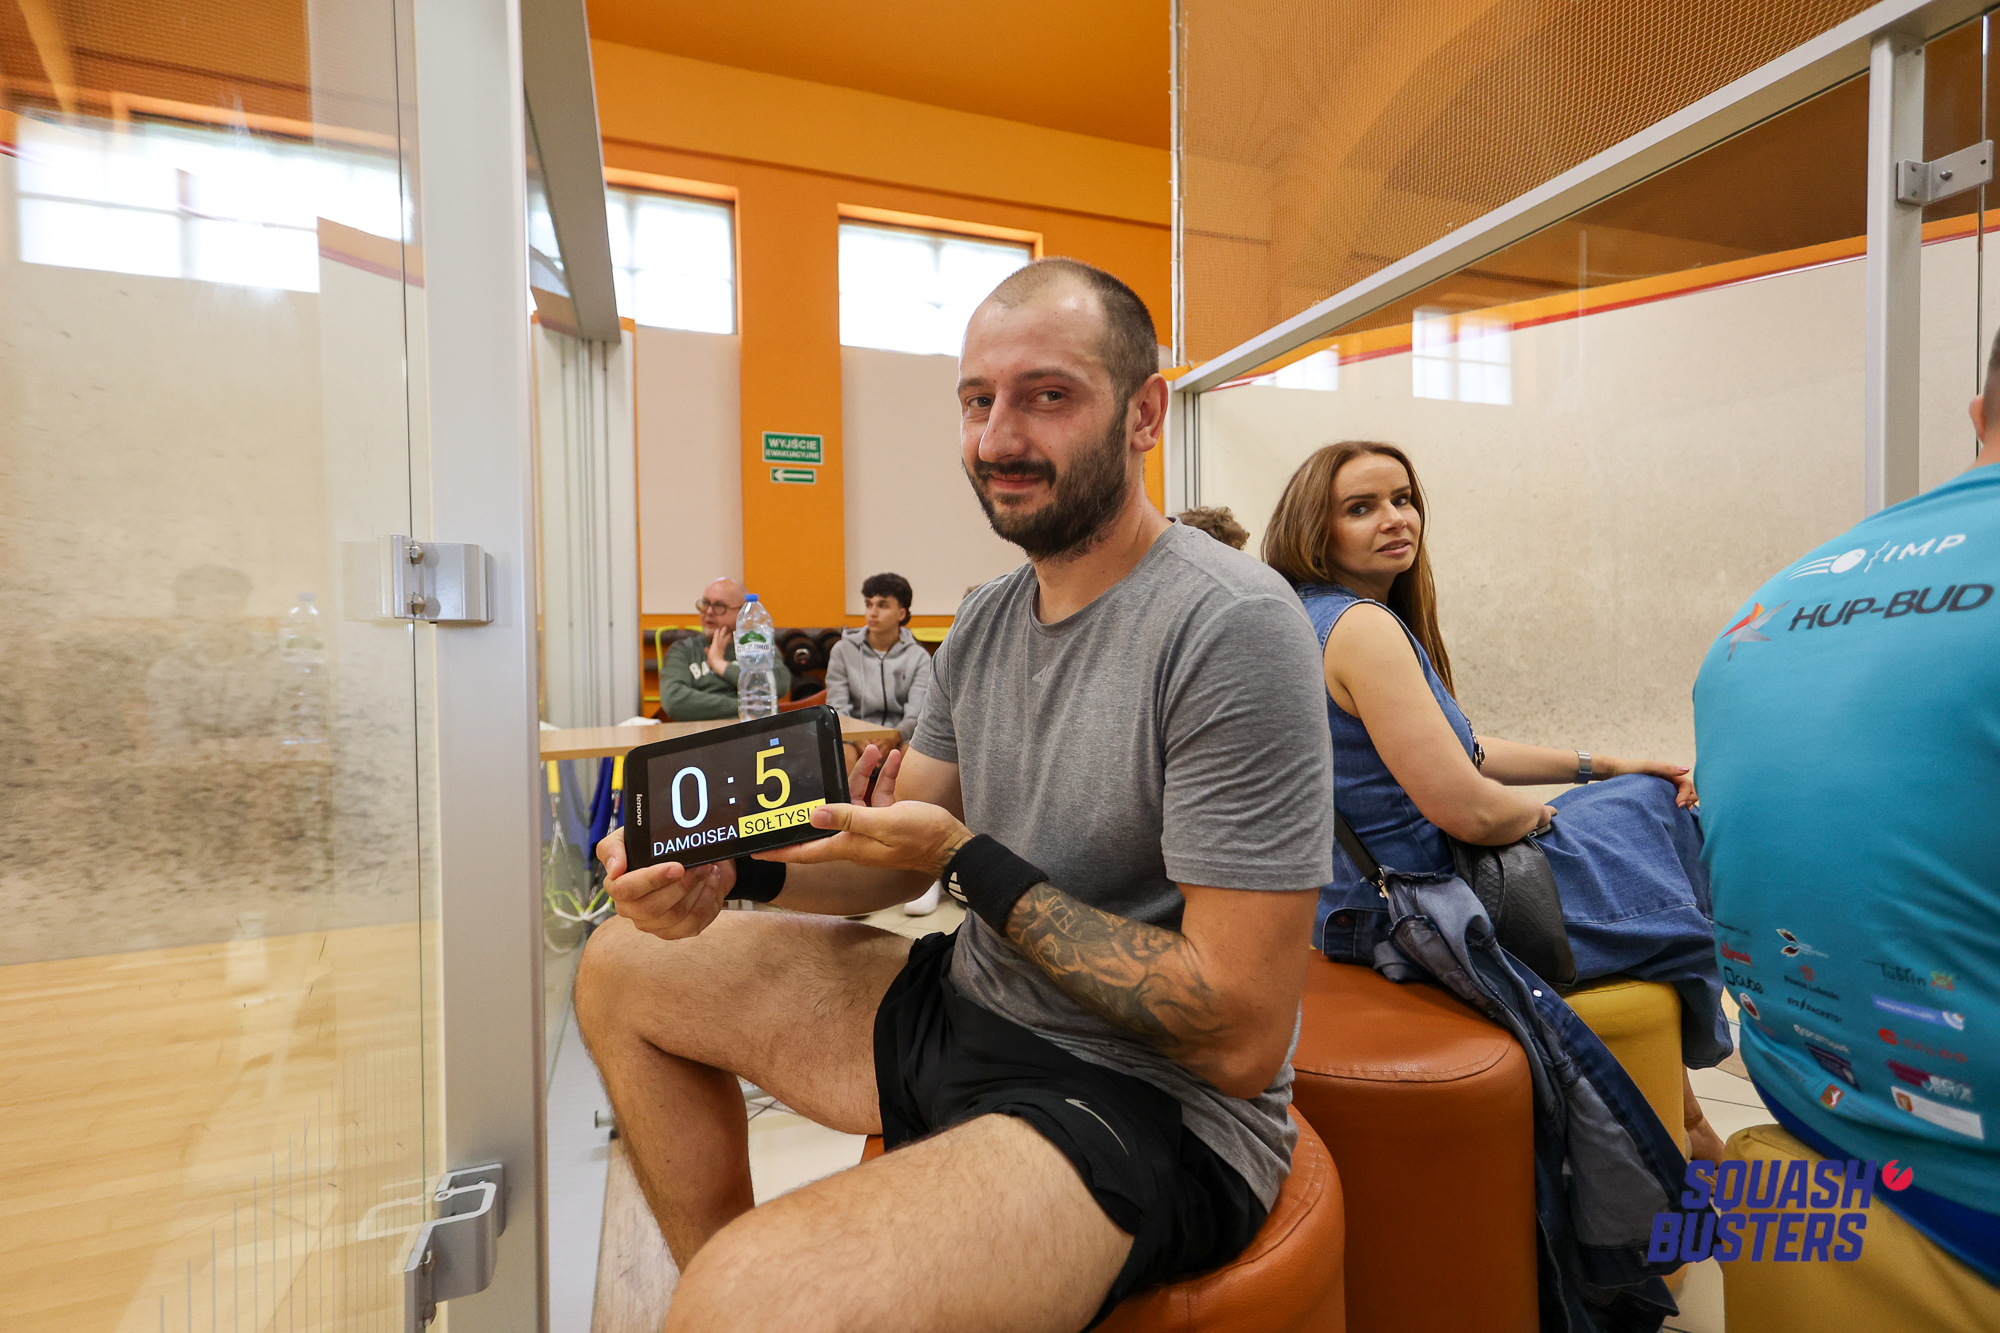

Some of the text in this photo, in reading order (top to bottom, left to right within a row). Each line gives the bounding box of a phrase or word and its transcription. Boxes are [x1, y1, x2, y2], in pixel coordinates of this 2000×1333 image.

[765, 448, 820, 460] EWAKUACYJNE
[768, 436, 818, 450] WYJŚCIE
[1882, 533, 1967, 563] IMP
[1787, 582, 1995, 632] HUP-BUD
[671, 766, 709, 829] 0
[755, 745, 791, 809] 5
[635, 793, 643, 826] lenovo
[653, 806, 815, 857] DAMOISEA SOŁTYSI
